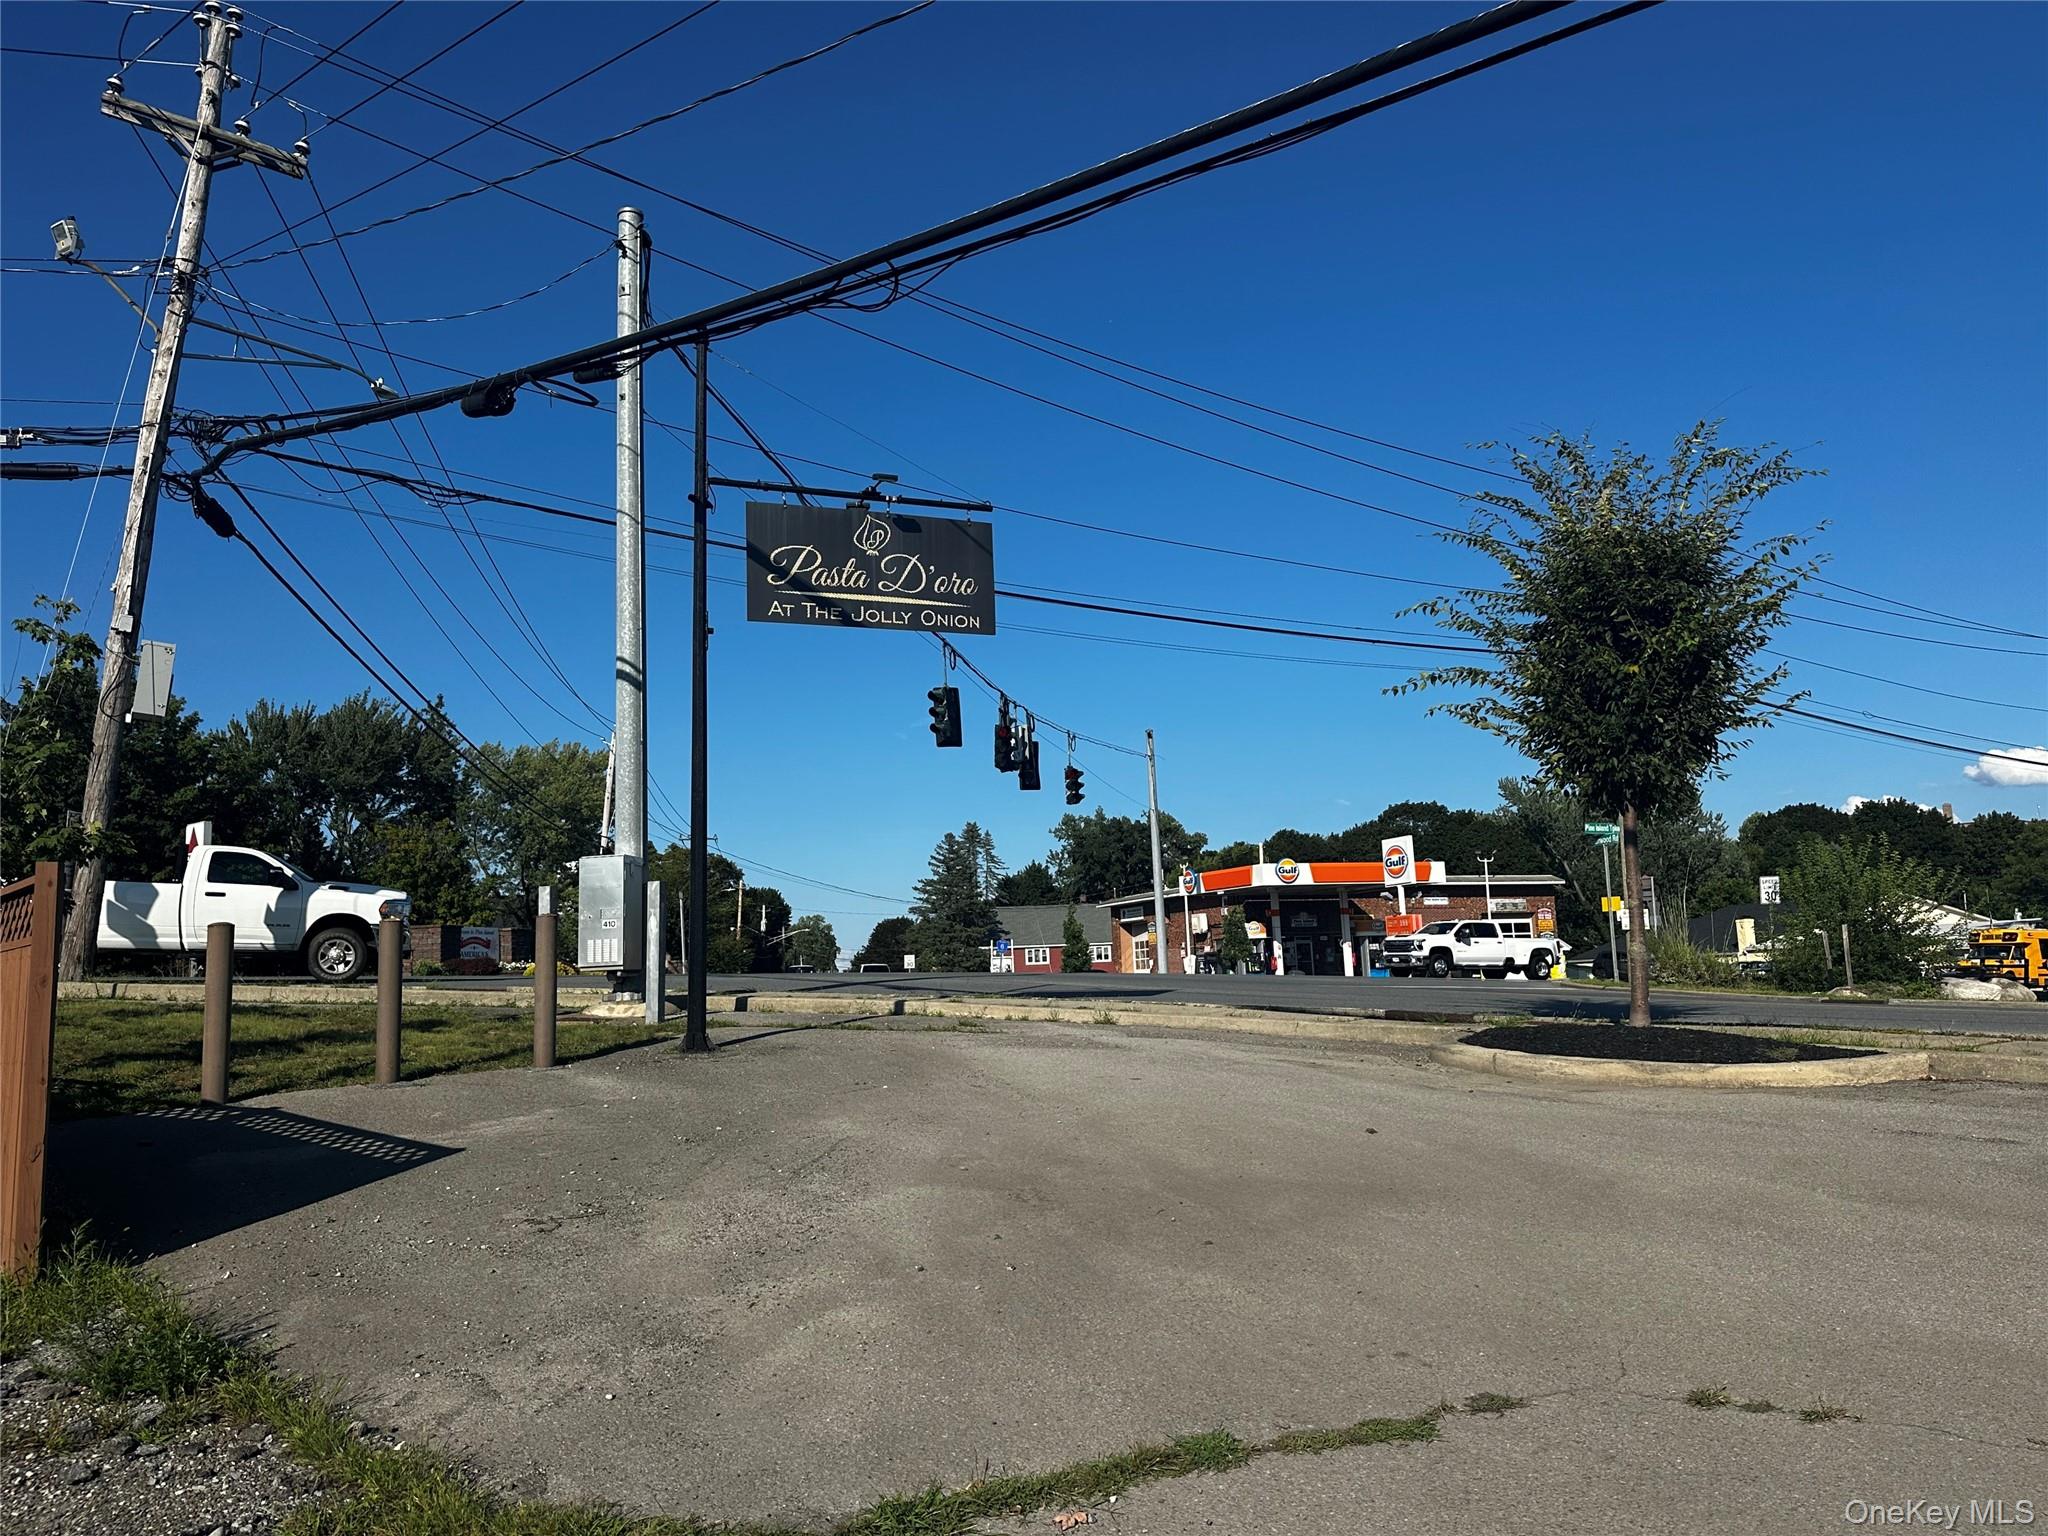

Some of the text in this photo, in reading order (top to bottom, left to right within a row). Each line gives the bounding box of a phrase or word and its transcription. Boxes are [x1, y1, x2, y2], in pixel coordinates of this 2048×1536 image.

[767, 545, 979, 596] Pasta D'oro
[1385, 855, 1406, 868] Gulf
[1278, 866, 1298, 874] Gulf
[1183, 877, 1194, 885] Gulf
[1764, 890, 1777, 901] 30
[603, 920, 616, 928] 410
